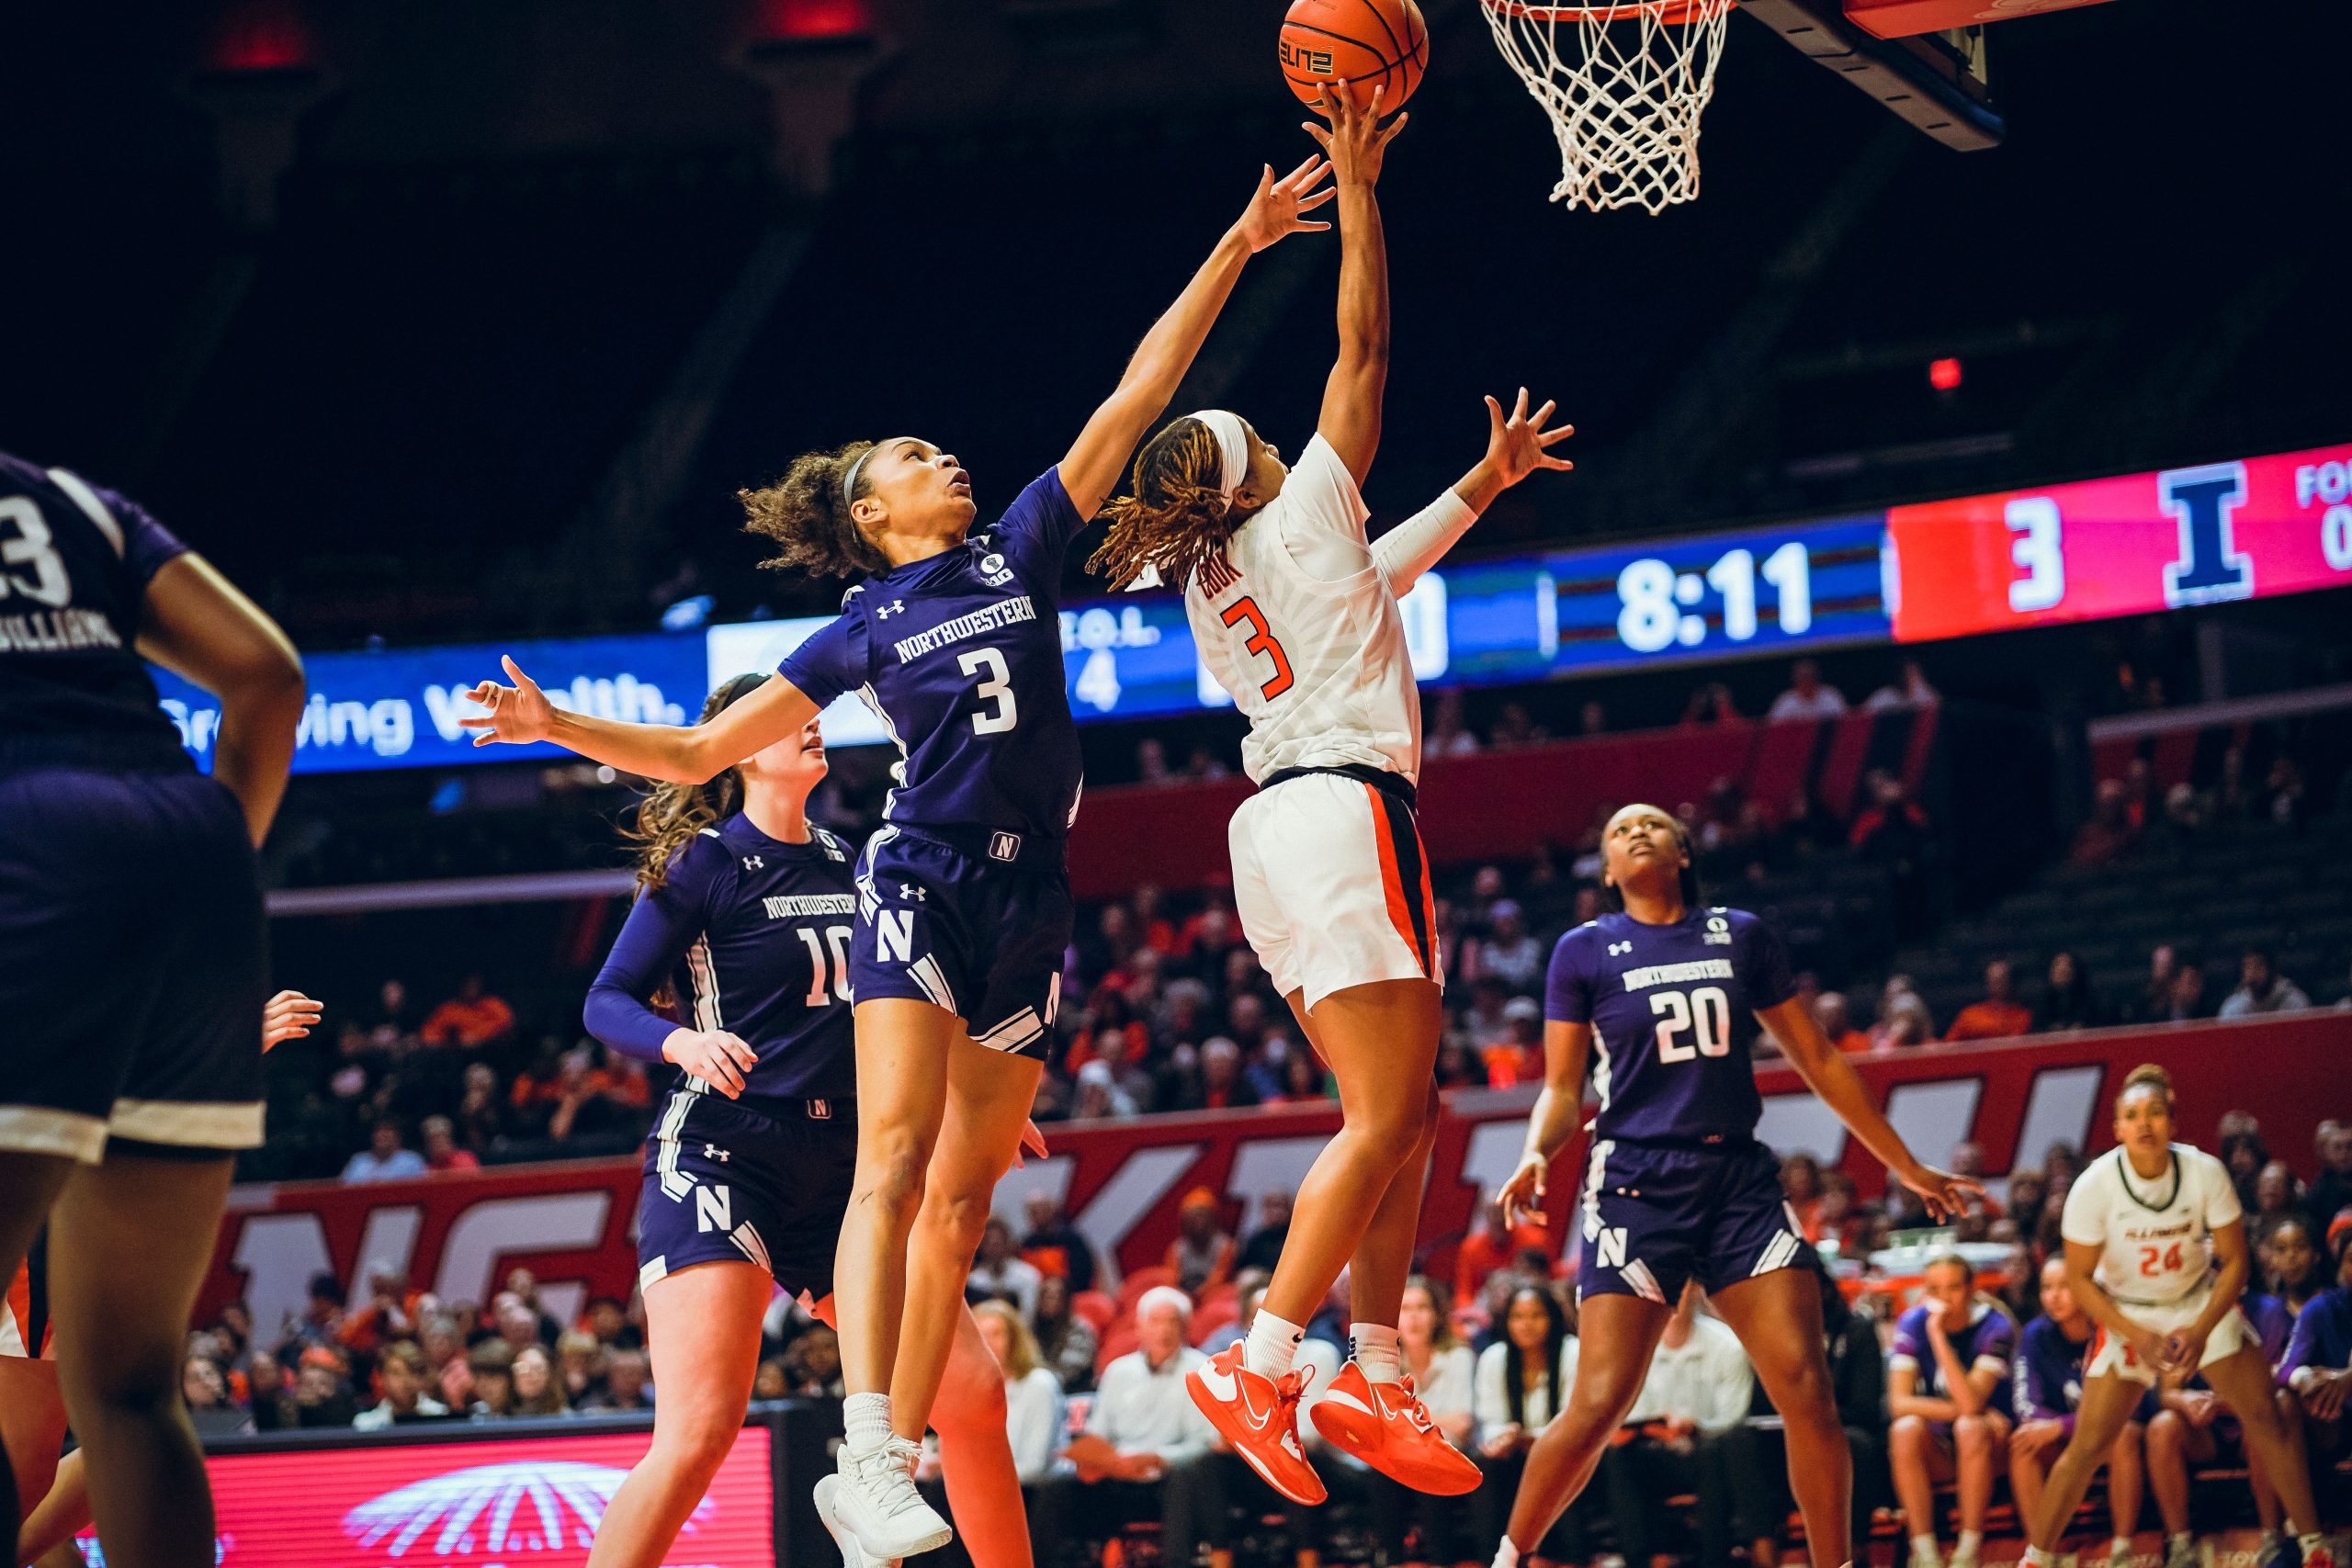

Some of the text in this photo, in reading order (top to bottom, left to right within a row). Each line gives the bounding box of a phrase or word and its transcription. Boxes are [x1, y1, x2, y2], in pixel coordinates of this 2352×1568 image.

[1280, 39, 1334, 74] ELITE
[2295, 460, 2352, 509] FO
[0, 496, 72, 609] 3
[2004, 496, 2065, 613] 3
[894, 596, 1036, 664] NORTHWESTERN
[1616, 541, 1812, 653] 8:11
[1075, 645, 1122, 713] 4
[1219, 595, 1295, 703] 3
[956, 647, 1018, 736] 3
[996, 837, 1014, 858] N
[876, 909, 914, 963] N
[1649, 987, 1731, 1064] 20
[695, 1185, 731, 1233] N
[1596, 1227, 1628, 1268] N
[2140, 1242, 2184, 1278] 24
